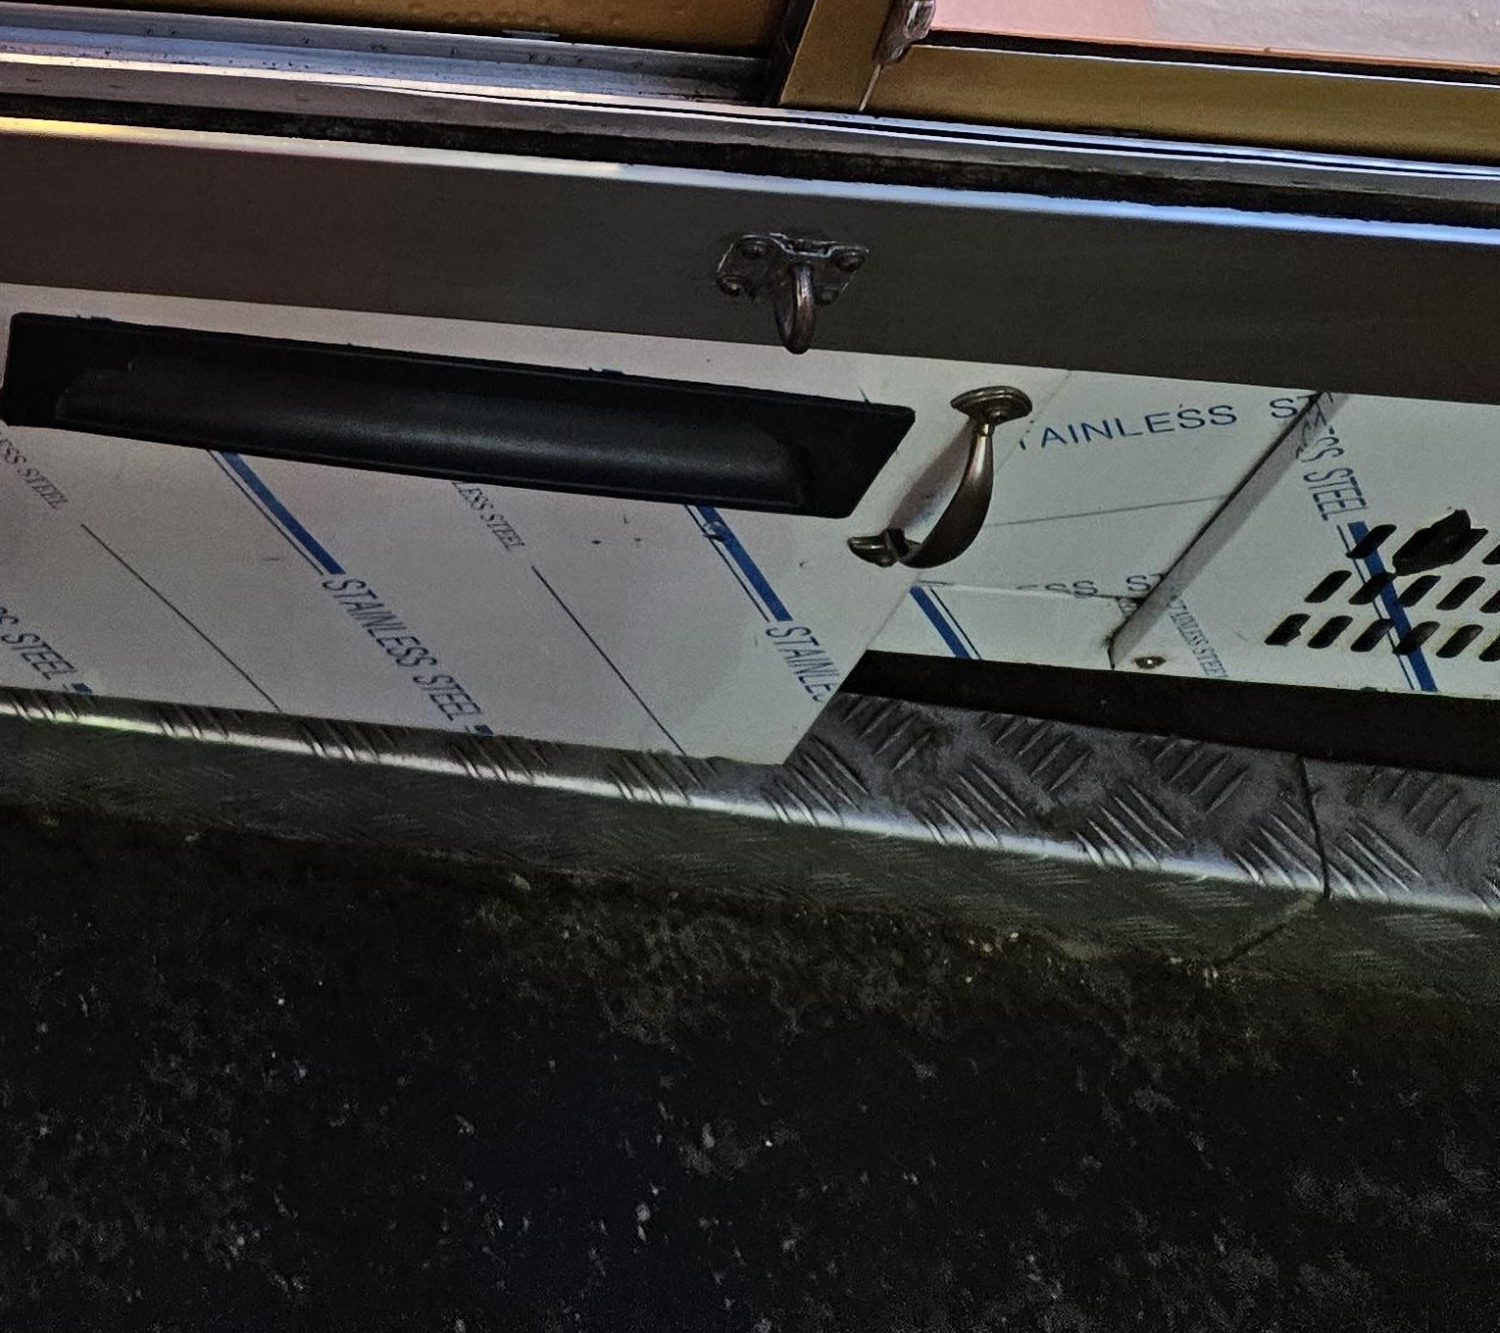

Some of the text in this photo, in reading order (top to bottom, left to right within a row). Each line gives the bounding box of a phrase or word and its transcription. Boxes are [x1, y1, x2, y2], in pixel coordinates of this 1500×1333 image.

[0, 632, 79, 681] STEEL
[321, 578, 482, 722] STAINLESS STEEL
